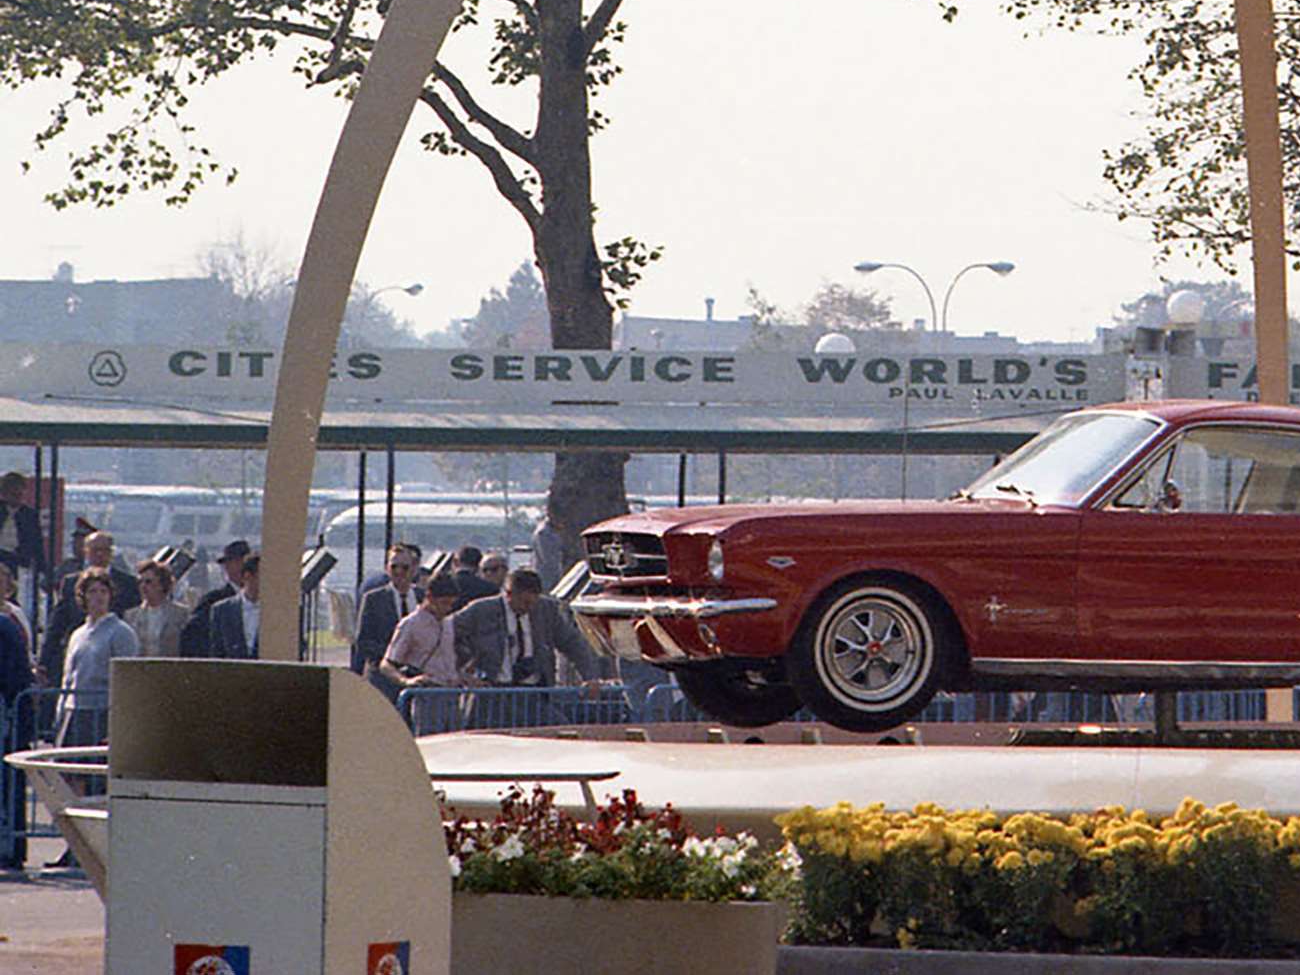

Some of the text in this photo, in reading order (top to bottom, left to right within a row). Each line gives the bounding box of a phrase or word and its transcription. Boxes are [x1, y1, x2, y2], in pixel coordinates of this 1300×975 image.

[168, 350, 383, 379] CITS
[450, 354, 736, 383] SERVICE
[797, 357, 1088, 385] WORLD'S
[889, 388, 954, 400] PAUL
